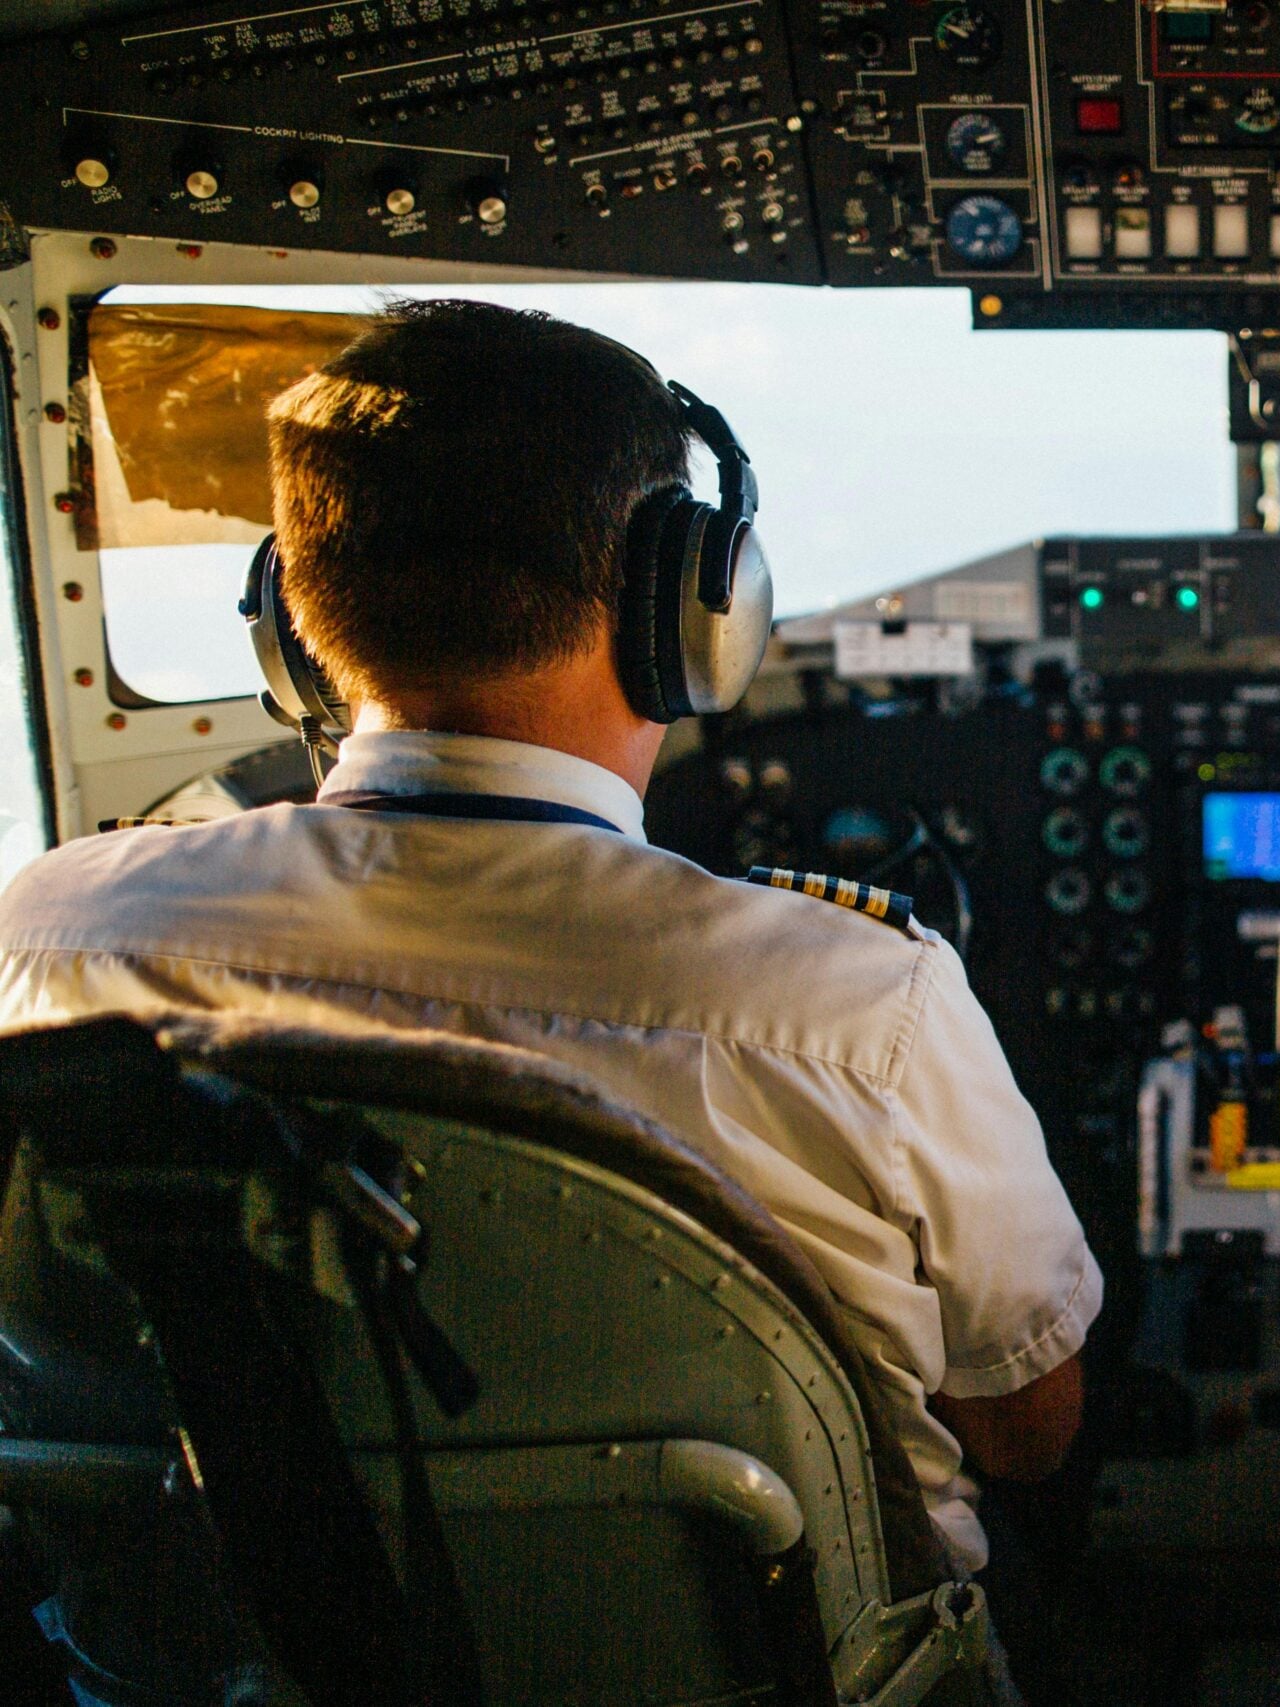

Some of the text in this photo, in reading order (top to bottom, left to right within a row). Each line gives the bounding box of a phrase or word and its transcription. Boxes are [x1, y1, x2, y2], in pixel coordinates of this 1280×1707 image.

[474, 45, 495, 56] GEN
[496, 41, 516, 51] BUS
[254, 126, 344, 145] COCKPIT LIGHTING
[60, 178, 76, 189] OFF
[90, 185, 117, 197] RADIO
[169, 191, 186, 202] OFF
[92, 193, 122, 205] LIGHTS
[189, 196, 233, 211] OVERHEAD
[271, 199, 287, 210] OFF
[200, 205, 227, 215] PANEL
